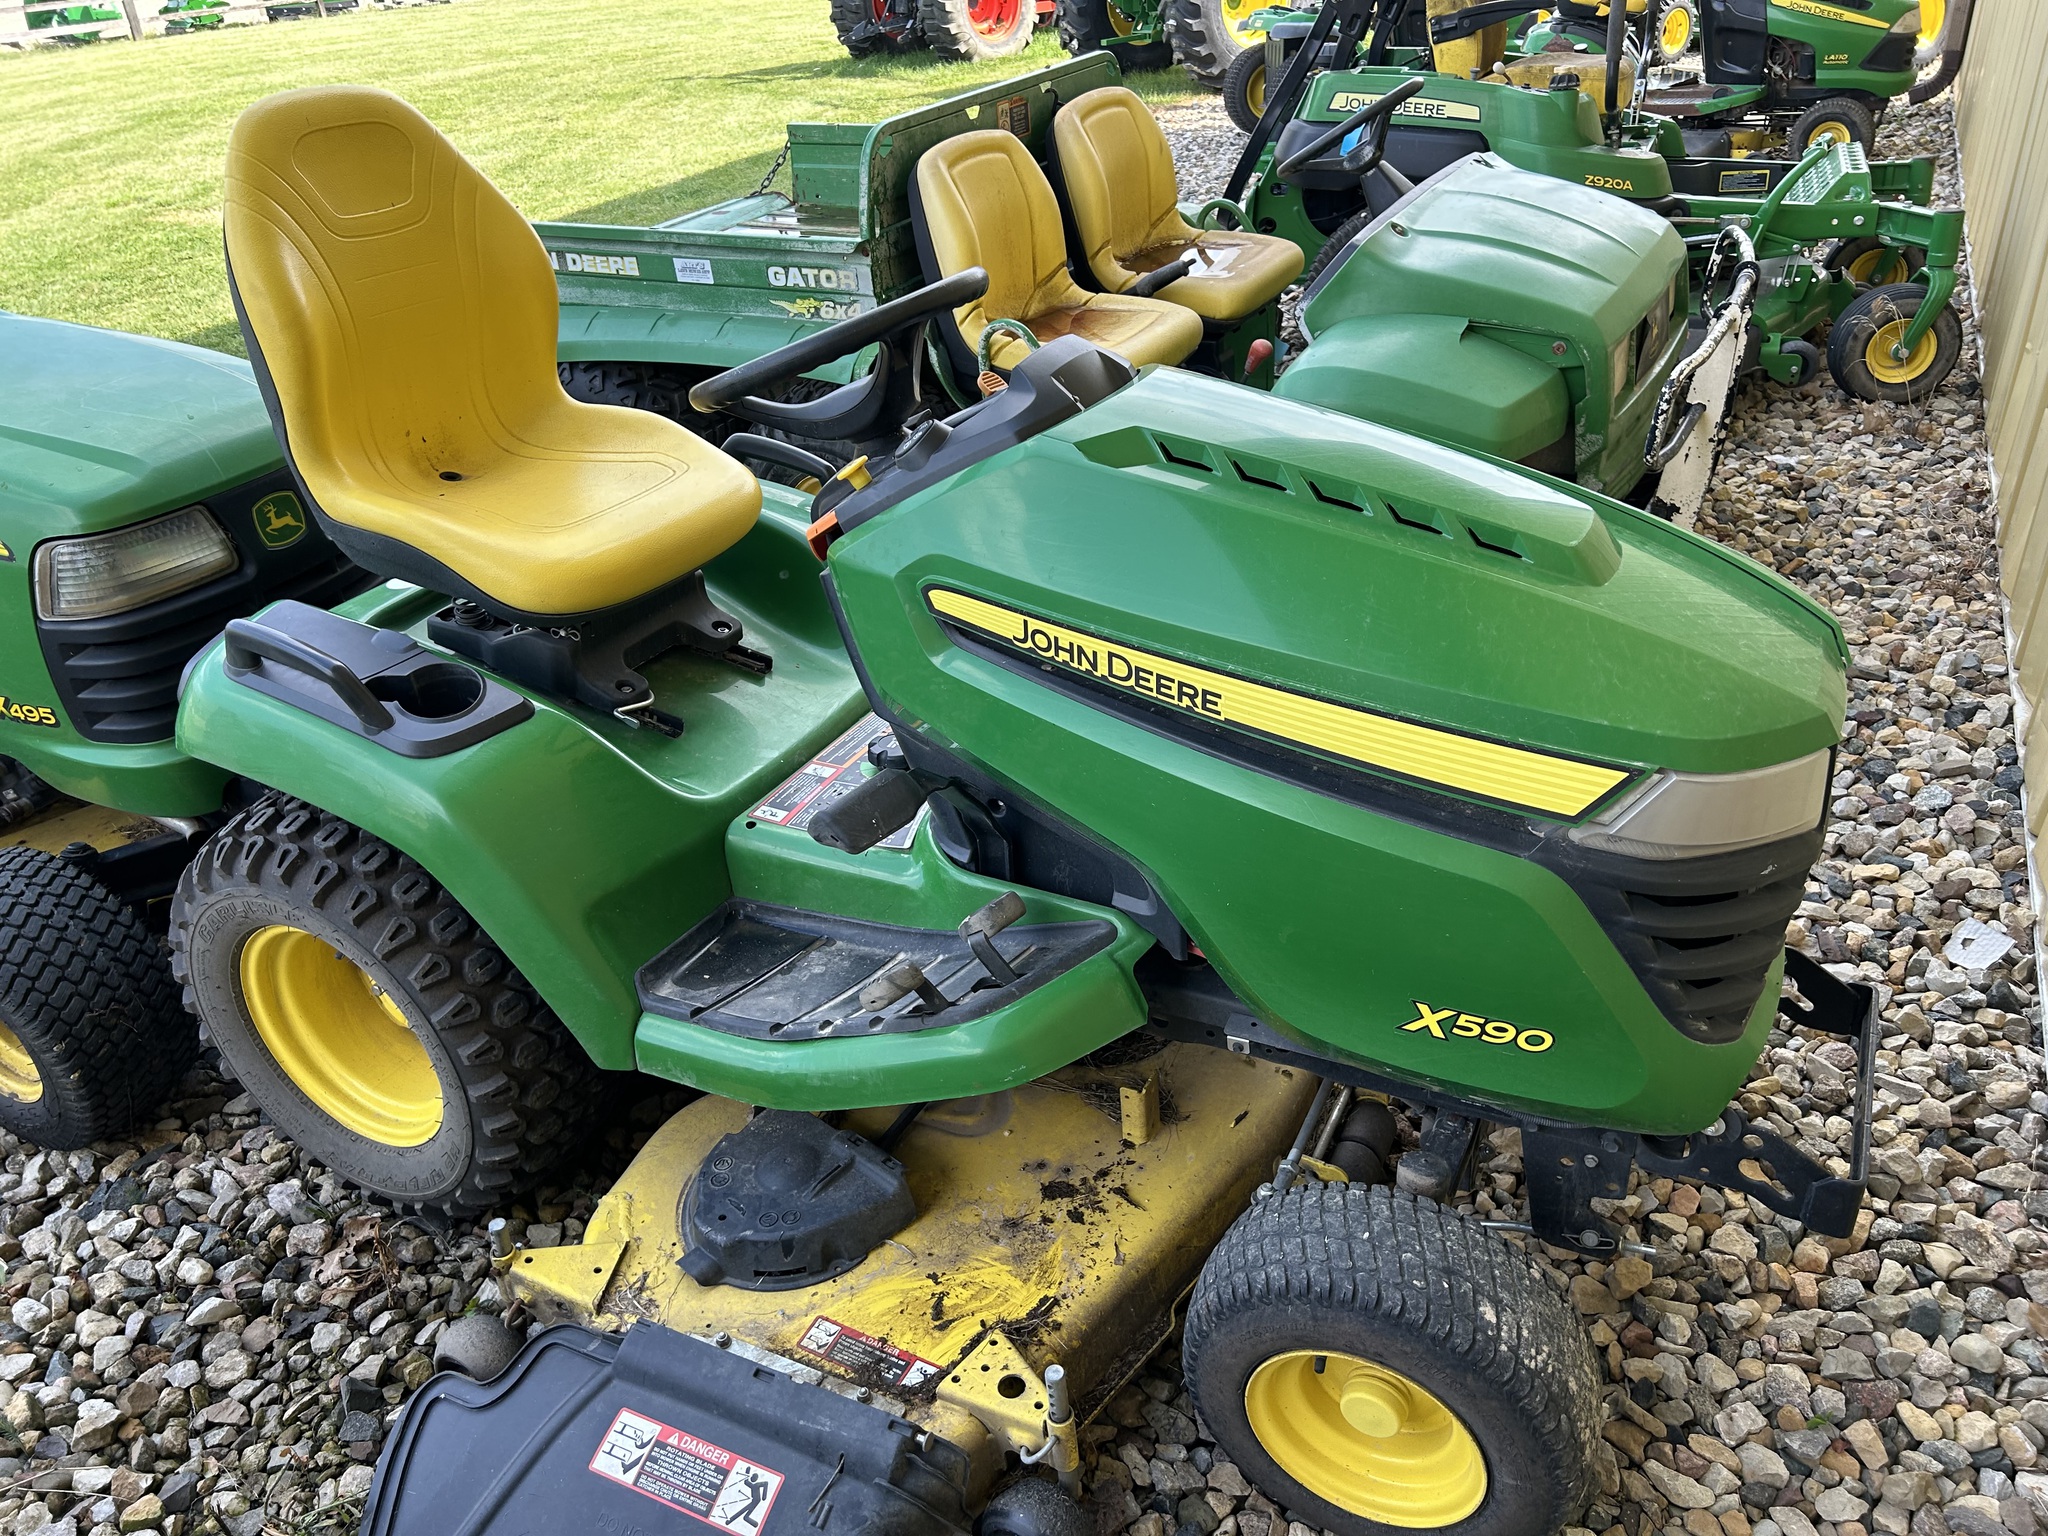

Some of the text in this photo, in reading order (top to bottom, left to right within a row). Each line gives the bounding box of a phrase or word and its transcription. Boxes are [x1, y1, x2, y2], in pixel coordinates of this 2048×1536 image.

[1787, 1, 1845, 19] JOHN DEERE
[1584, 174, 1633, 191] Z920A
[565, 252, 640, 276] DEERE
[767, 266, 857, 289] GATOR
[1013, 619, 1222, 716] JOHN DEERE
[1400, 1001, 1554, 1052] X590
[665, 1445, 715, 1470] ROTATING BLADE
[680, 1435, 730, 1465] DANGER
[656, 1459, 709, 1486] THROWN OBJECTS
